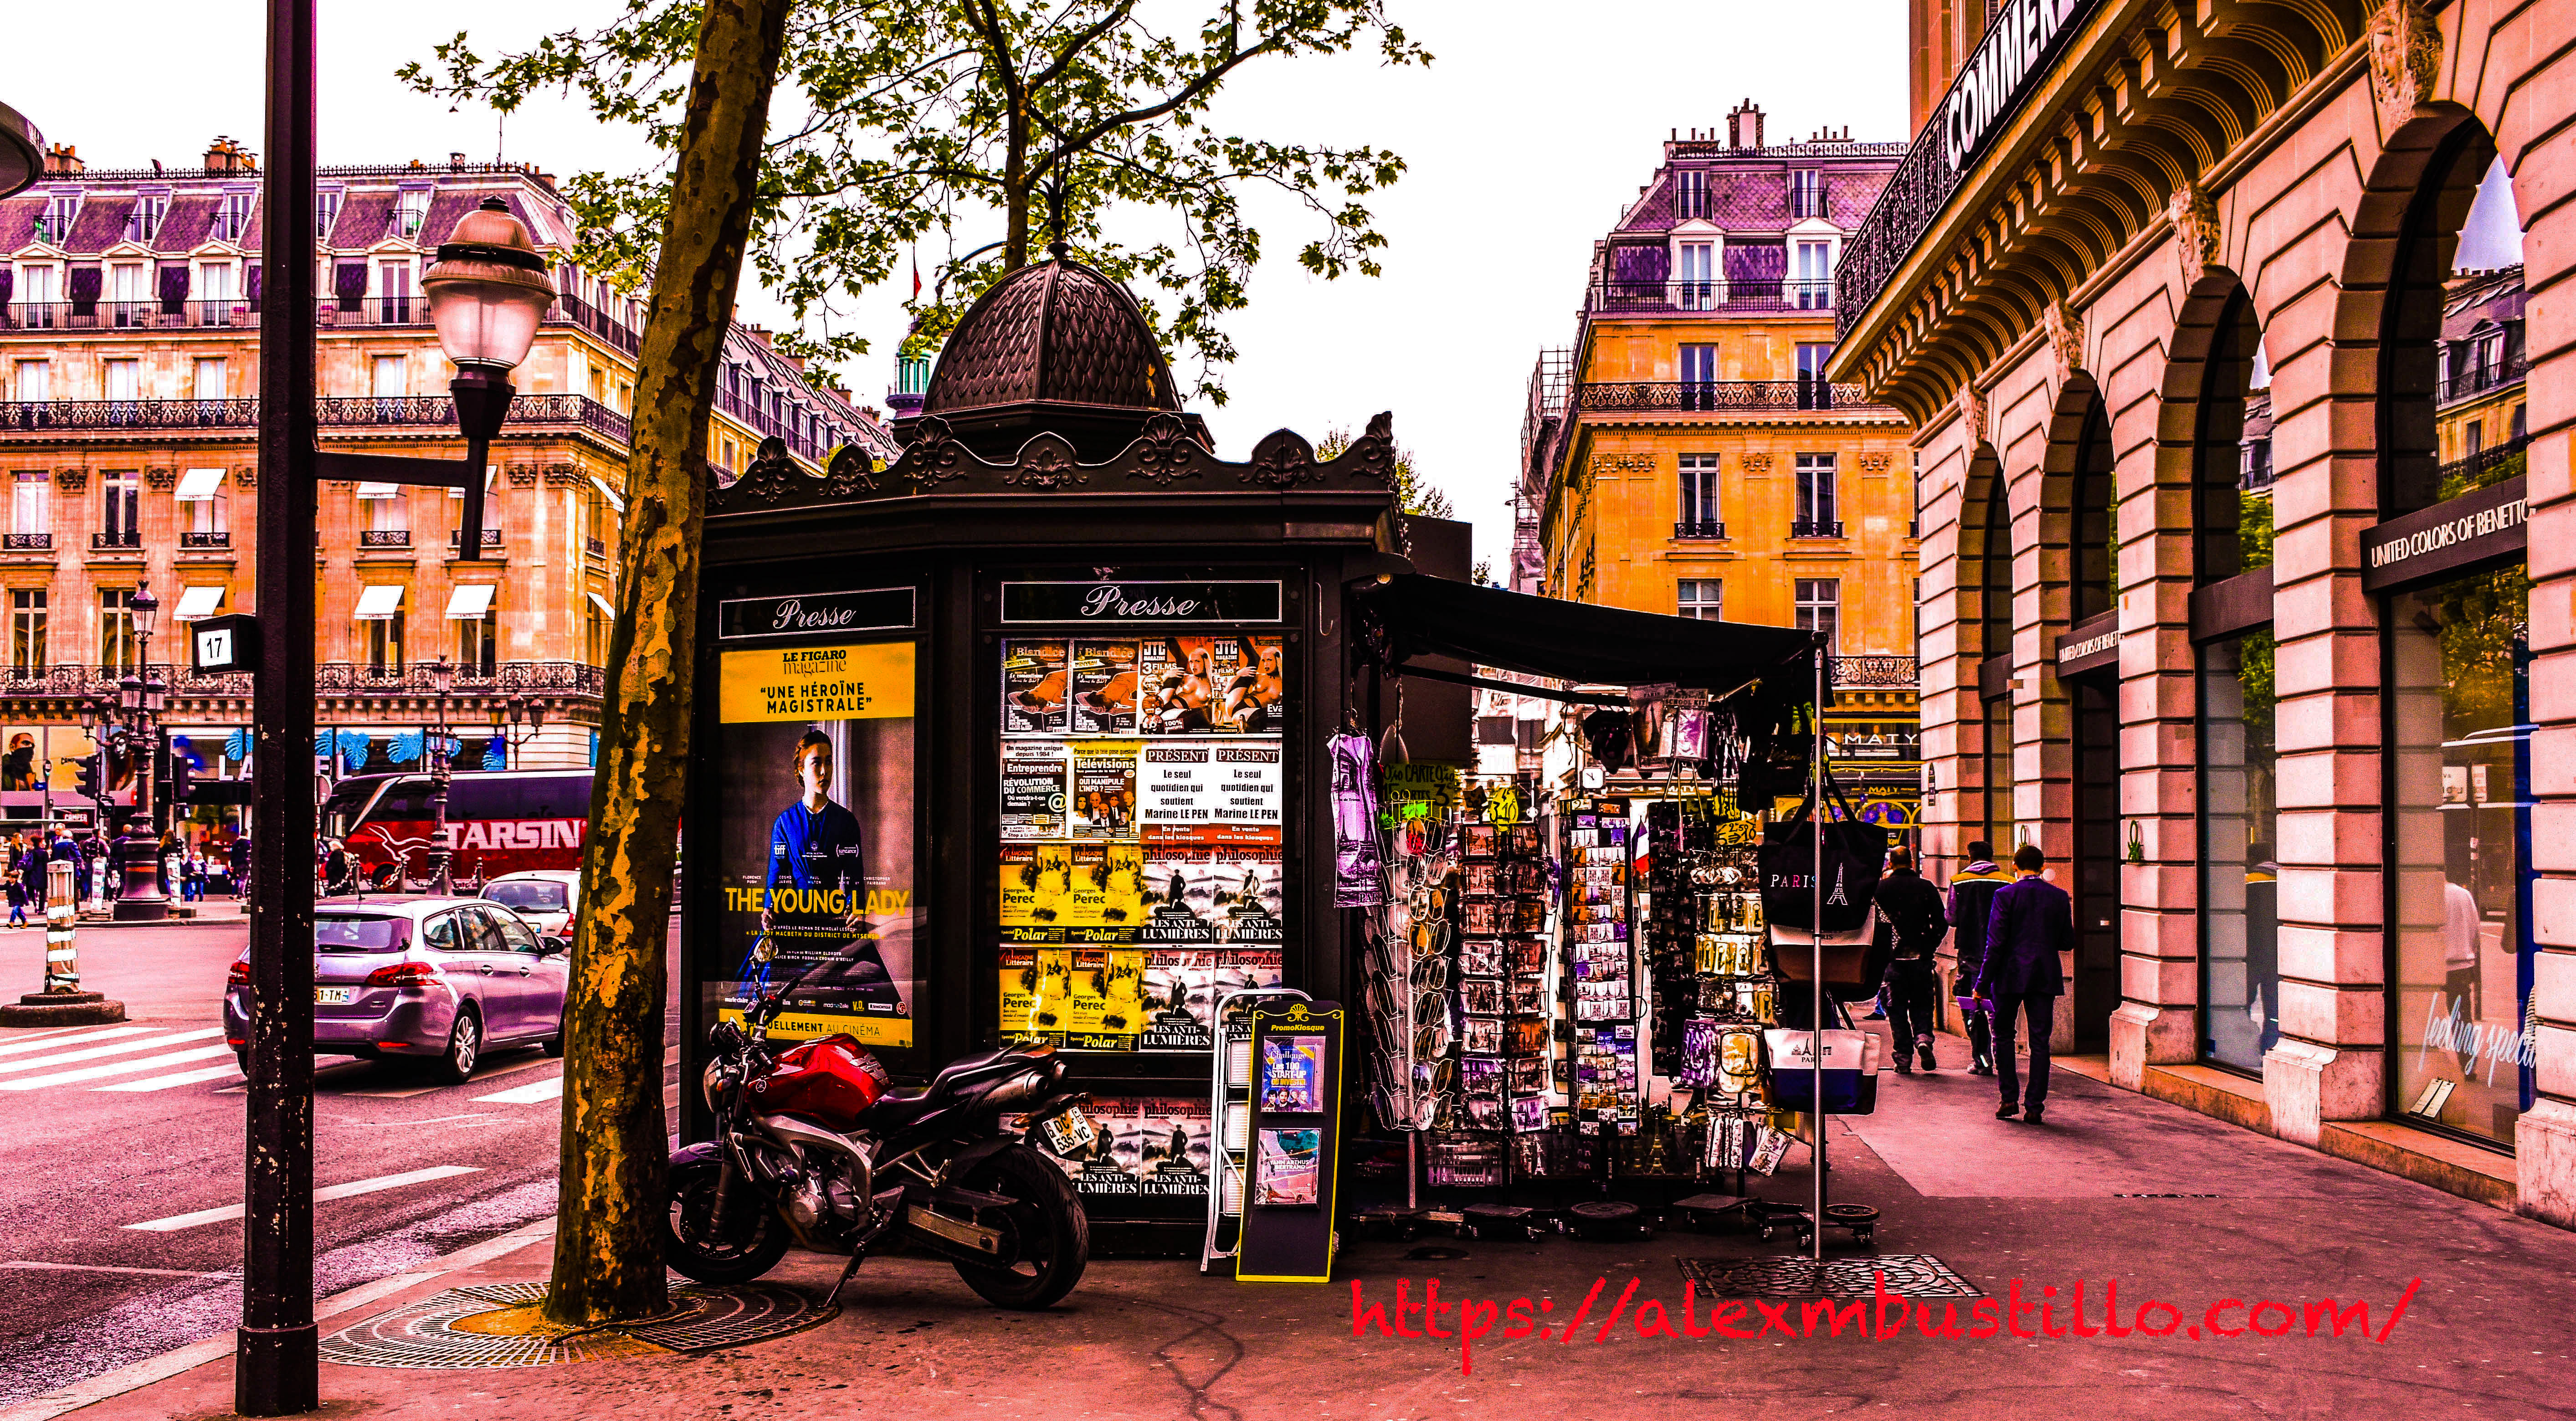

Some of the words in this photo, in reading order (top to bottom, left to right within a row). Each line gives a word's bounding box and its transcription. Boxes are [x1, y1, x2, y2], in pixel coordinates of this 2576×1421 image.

[2371, 537, 2410, 568] UNITED
[2410, 521, 2457, 556] COLORS
[2458, 515, 2475, 541] OF
[2477, 498, 2536, 536] BENETTO
[1081, 585, 1201, 616] Presse
[773, 599, 857, 629] Presse
[207, 637, 222, 658] 17
[1016, 646, 1065, 656] Blandice
[1085, 647, 1134, 657] Blandice
[783, 652, 798, 663] LE
[801, 650, 847, 662] FIGARO
[784, 660, 847, 678] magazine
[1142, 662, 1152, 674] 3
[760, 685, 795, 699] “UNE
[801, 680, 865, 698] HÉROÏNE
[767, 697, 872, 714] MAGISTRALE”
[1267, 703, 1282, 712] Eva
[1845, 734, 1917, 744] MATY
[1148, 749, 1208, 762] PRÉSENT
[1218, 749, 1278, 762] PRÉSENT
[1007, 764, 1063, 774] Entreprendre
[1075, 758, 1135, 769] Télévisions
[1164, 769, 1172, 778] Le
[1174, 770, 1191, 778] seul
[1234, 769, 1243, 778] Le
[1244, 770, 1261, 778] seul
[1405, 765, 1435, 783] CARTE
[1003, 777, 1053, 787] RÉVOLUTION
[1016, 785, 1060, 793] COMMERCE
[1151, 784, 1189, 792] quotidien
[1191, 784, 1203, 792] qui
[1221, 784, 1259, 792] quotidien
[1260, 784, 1273, 792] qui
[1230, 797, 1263, 805] soutient
[1145, 809, 1178, 819] Marine
[1180, 809, 1189, 819] LE
[1192, 809, 1208, 819] PEN
[1215, 808, 1247, 819] Marine
[1250, 809, 1259, 819] LE
[1261, 810, 1278, 819] PEN
[1142, 849, 1211, 864] philosophie
[1216, 849, 1282, 864] philosophie
[725, 887, 765, 913] THE
[769, 888, 845, 914] YOUNG
[852, 889, 909, 916] LADY
[1003, 893, 1035, 903] Perec
[1073, 894, 1106, 904] Perec
[1173, 920, 1200, 929] ANTI-
[1247, 920, 1273, 929] ANTI-
[1013, 928, 1047, 941] Polar
[1085, 928, 1118, 941] Polar
[1143, 926, 1209, 939] LUMIÈRES
[1216, 926, 1283, 939] LUMIÈRES
[1003, 998, 1037, 1008] Perec
[1073, 1000, 1106, 1010] Perec
[826, 1024, 839, 1033] AU
[843, 1024, 880, 1036] CINÉMA
[1174, 1026, 1201, 1034] ANTI-
[2418, 992, 2483, 1075] feeling
[1014, 1033, 1048, 1044] Polar
[1083, 1035, 1118, 1048] Polar
[1144, 1031, 1210, 1046] LUMIÈRES
[1144, 1104, 1211, 1119] philosophie
[1100, 1174, 1127, 1183] ANTI-
[1155, 1174, 1171, 1182] LES
[1175, 1175, 1201, 1183] ANTI-
[1144, 1181, 1210, 1195] LUMIÈRES
